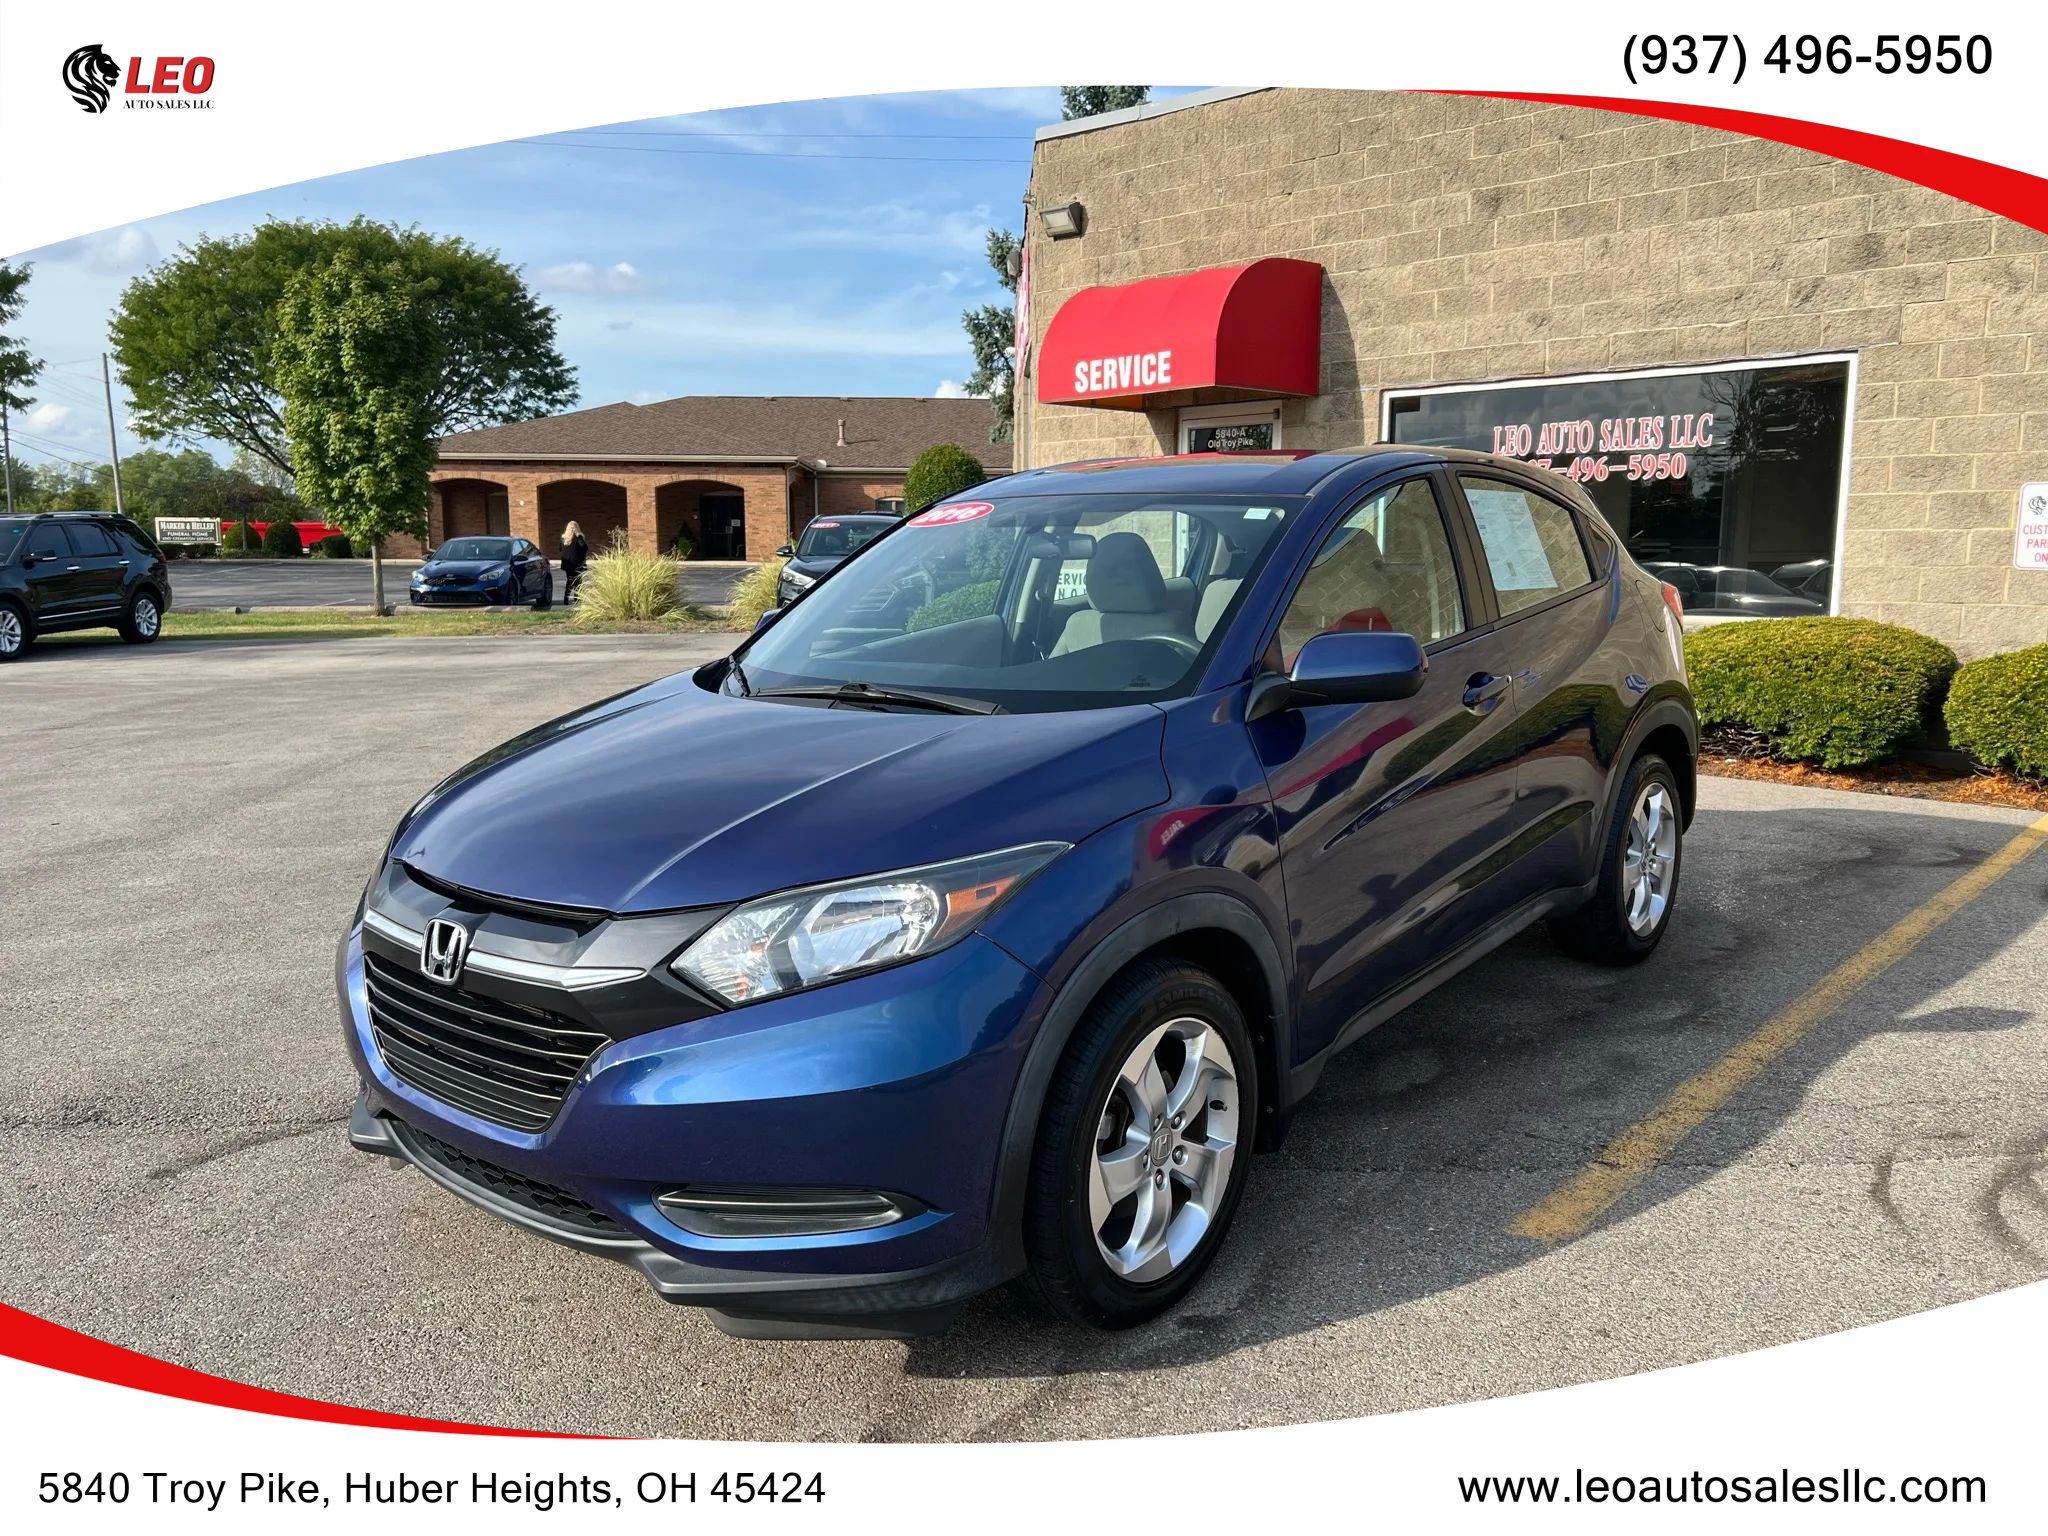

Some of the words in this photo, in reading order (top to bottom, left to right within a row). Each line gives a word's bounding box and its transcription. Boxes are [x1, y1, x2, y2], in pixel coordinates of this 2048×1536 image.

[1074, 350, 1172, 393] SERVICE
[1215, 427, 1247, 439] 5840-A
[1492, 423, 1532, 456] LEO
[1536, 419, 1594, 455] AUTO
[1600, 415, 1664, 452] SALES
[1669, 413, 1714, 448] LLC
[1207, 439, 1221, 448] Old
[1221, 438, 1236, 448] Troy
[1237, 437, 1254, 446] Pike
[160, 521, 185, 530] MARKER
